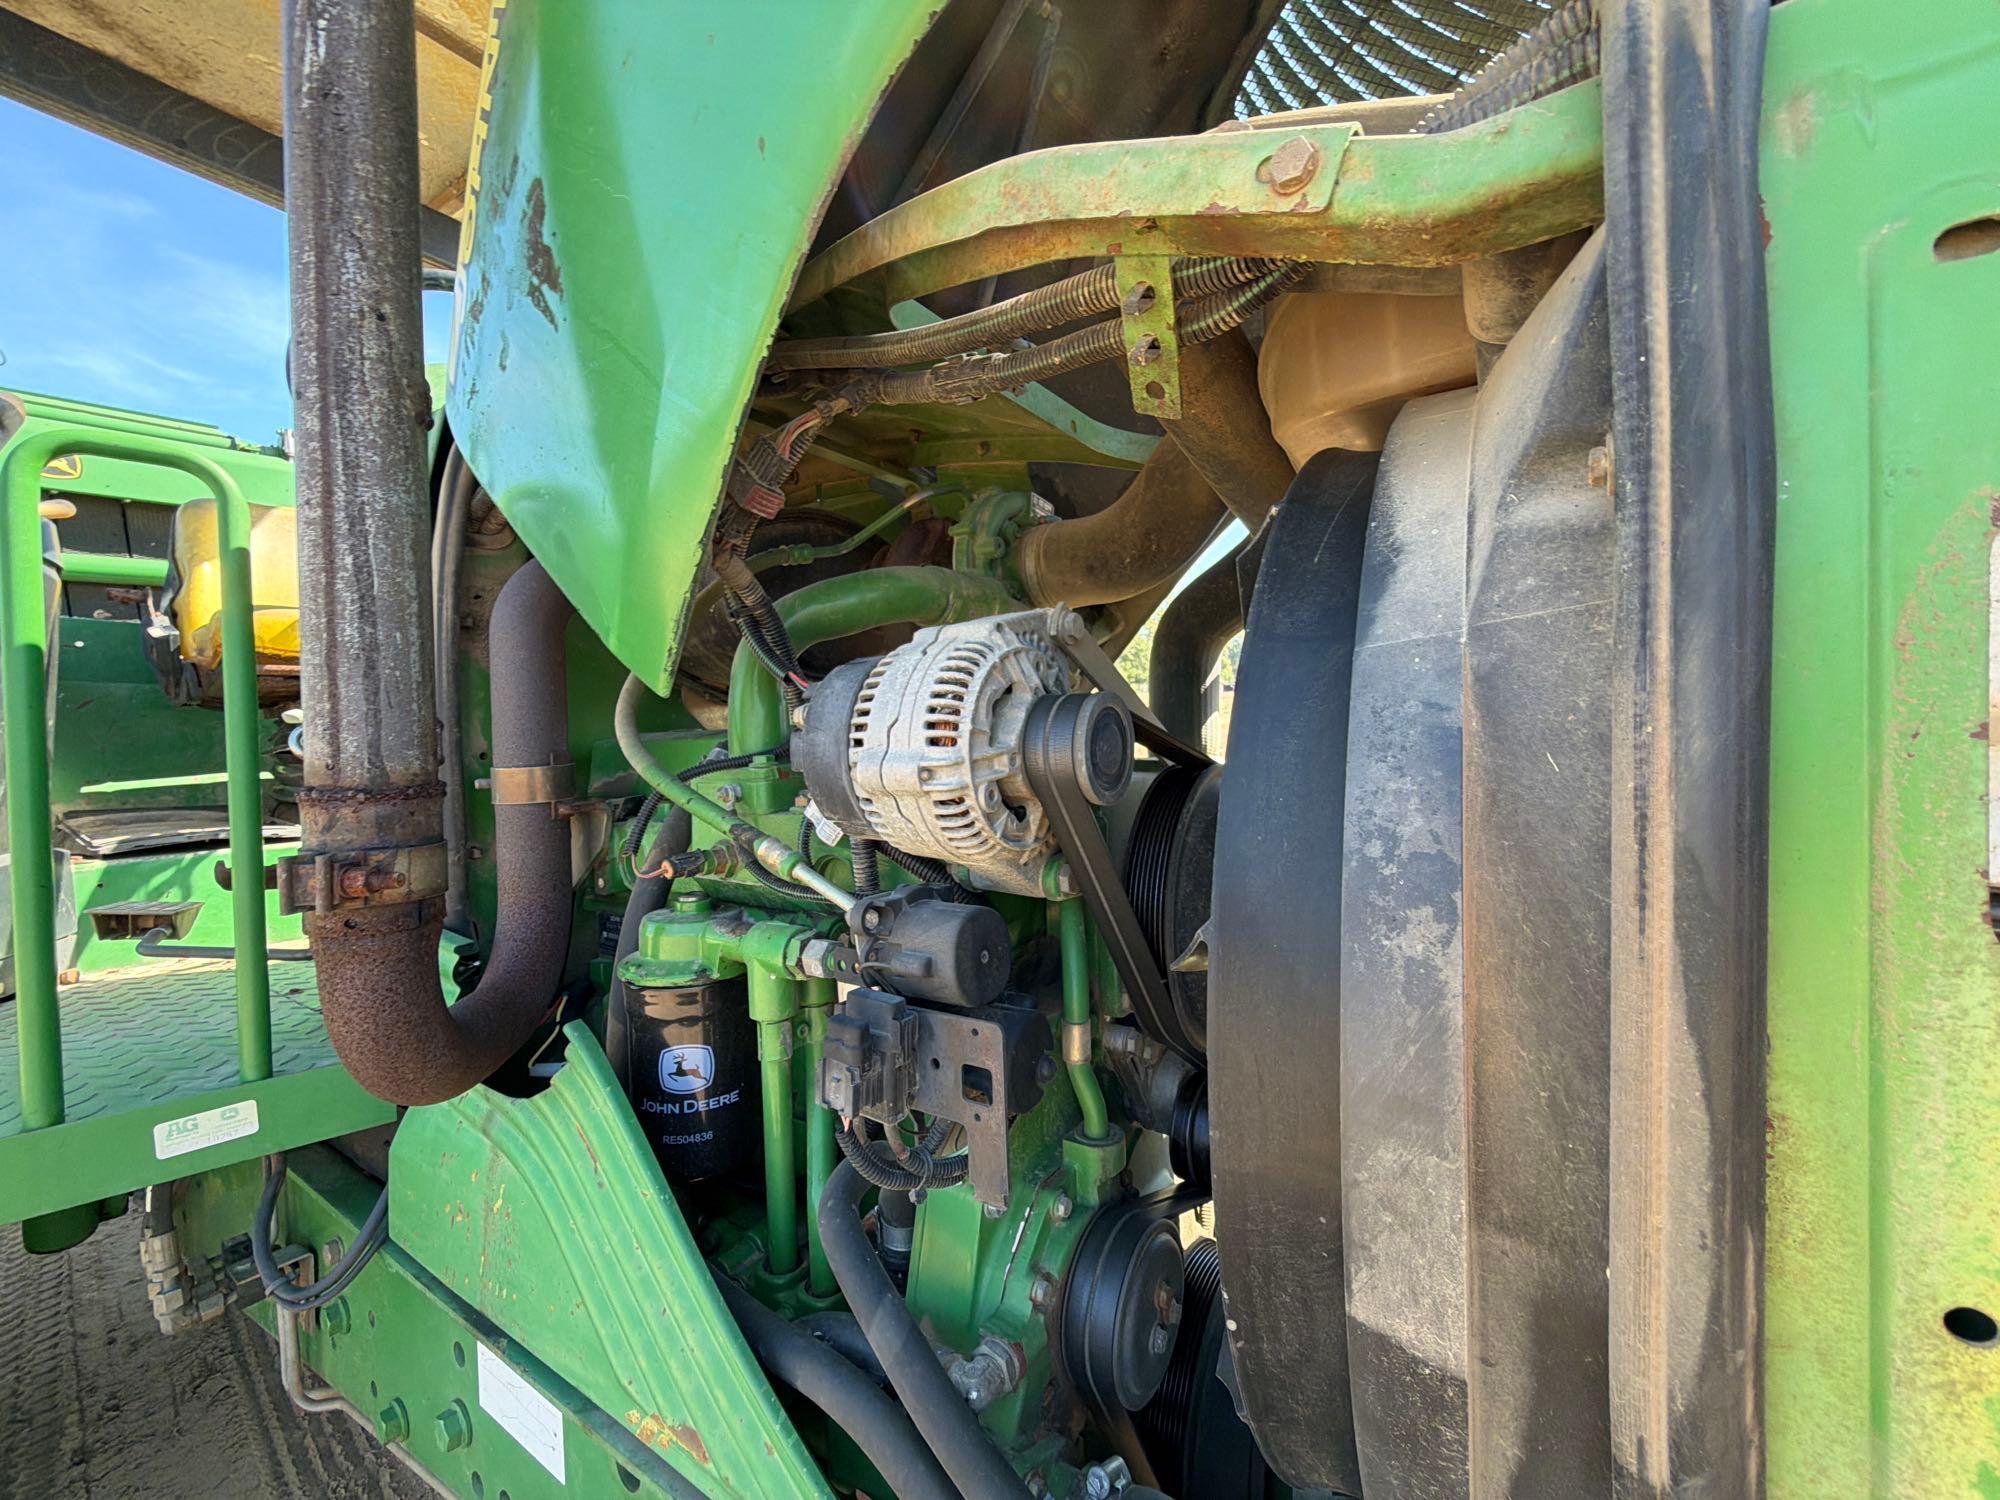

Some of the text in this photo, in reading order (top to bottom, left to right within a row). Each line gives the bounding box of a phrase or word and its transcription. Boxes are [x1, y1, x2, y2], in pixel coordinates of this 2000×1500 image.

[640, 1090, 740, 1115] JOHN DEERE
[165, 1117, 199, 1140] AG
[662, 1130, 714, 1145] RE504836
